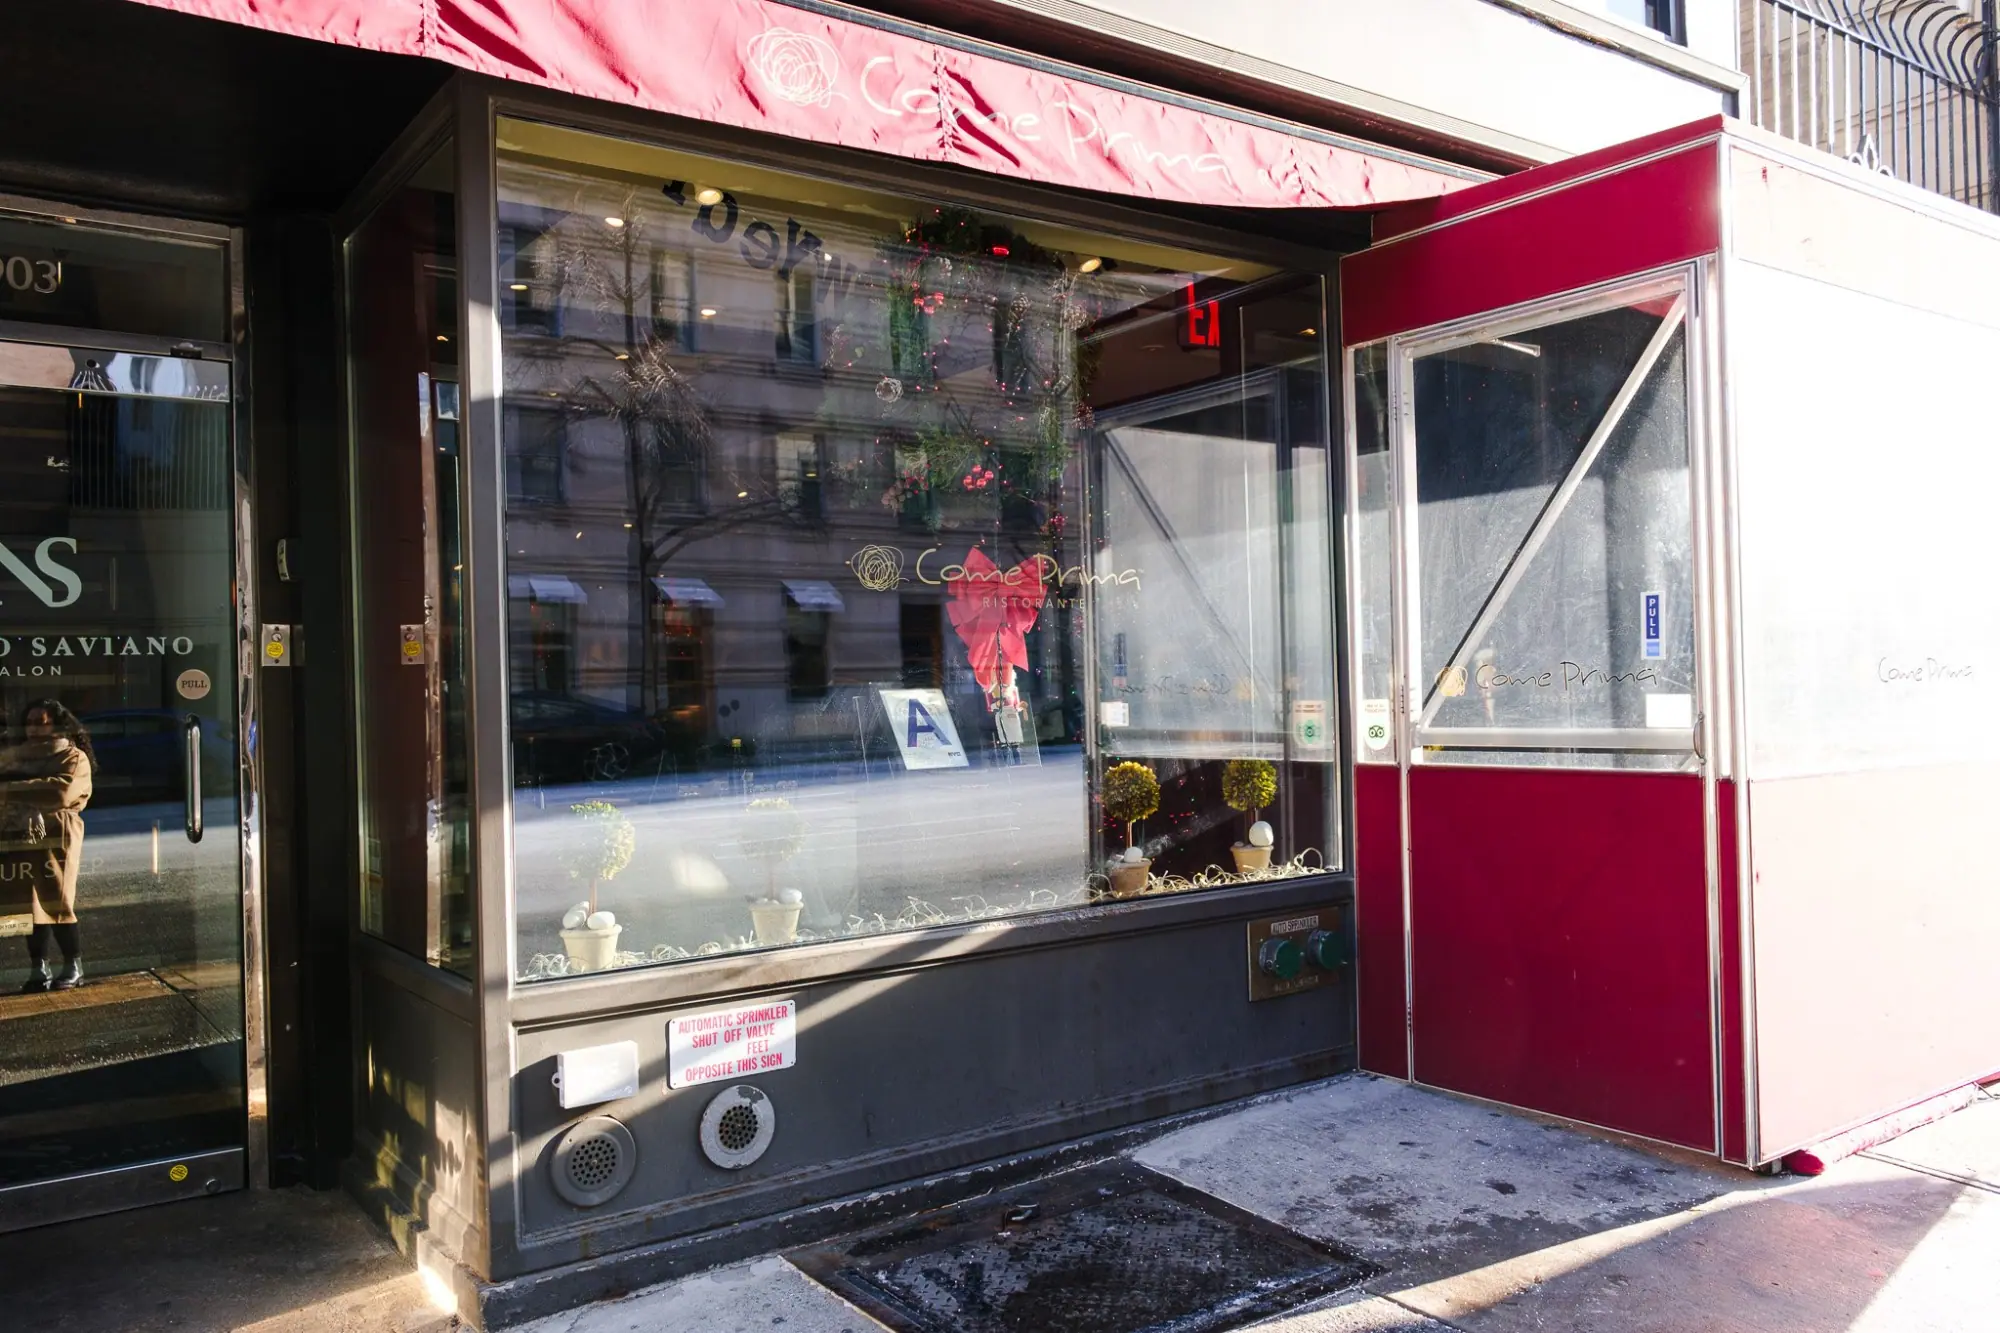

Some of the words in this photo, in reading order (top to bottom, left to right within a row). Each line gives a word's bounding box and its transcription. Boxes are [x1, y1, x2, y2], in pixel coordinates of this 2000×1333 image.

[859, 55, 1041, 142] Come
[1053, 100, 1233, 187] Prima
[0, 256, 57, 294] 03
[916, 547, 1023, 586] Come
[1032, 552, 1141, 594] Prima
[982, 597, 1086, 610] RISTORANTE
[1648, 598, 1657, 636] PULL
[31, 636, 194, 657] SAVIANO
[0, 665, 62, 678] ALON
[1475, 663, 1552, 689] Come
[1560, 660, 1658, 691] Prima
[1878, 656, 1923, 683] Come
[181, 680, 208, 690] PULL
[907, 698, 952, 747] A
[0, 861, 35, 881] UR
[678, 1014, 733, 1034] AUTOMATIC
[736, 1005, 788, 1026] SPRINKLER
[692, 1033, 719, 1048] SHUT
[723, 1028, 742, 1043] OFF
[746, 1022, 775, 1039] VALVE
[747, 1039, 769, 1054] FEET
[685, 1061, 733, 1082] OPPOSITE
[736, 1058, 758, 1073] THIS
[761, 1052, 783, 1068] SIGN
